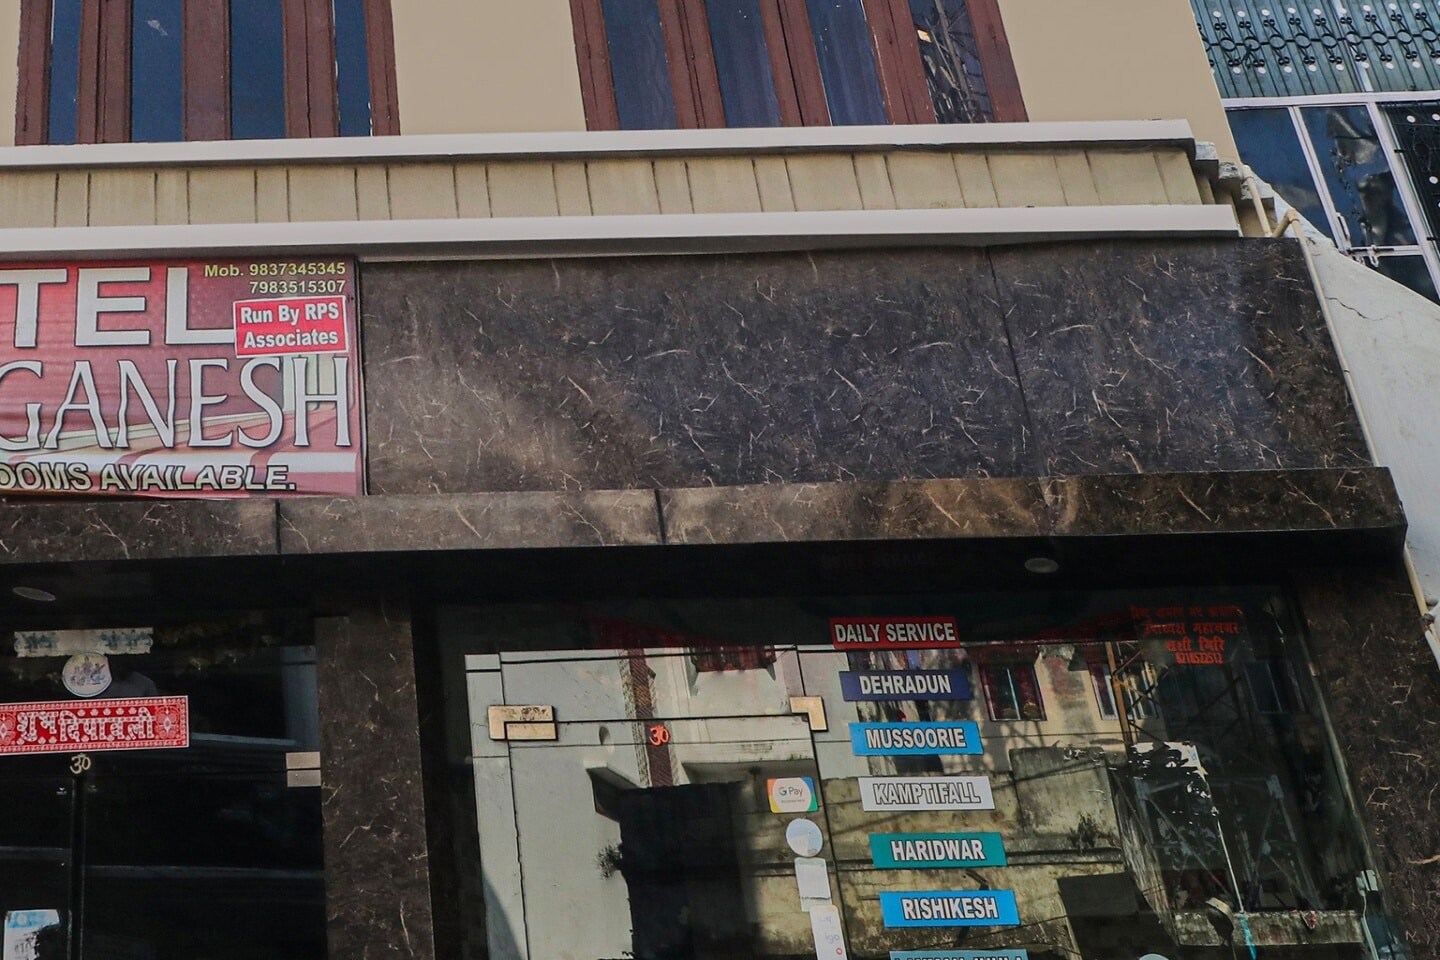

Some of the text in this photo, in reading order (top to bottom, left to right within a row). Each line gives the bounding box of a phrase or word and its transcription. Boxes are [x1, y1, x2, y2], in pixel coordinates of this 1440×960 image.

[204, 262, 346, 277] Mob. 9837345345
[249, 280, 346, 293] 7983515307
[240, 302, 340, 326] Run By RPS
[243, 328, 339, 349] Associates
[100, 464, 298, 491] AVAILABLE.
[834, 622, 957, 644] DAILY SERVICE
[860, 673, 952, 696] DEHRADUN
[16, 711, 58, 742] शुभ
[865, 727, 966, 750] MUSSOORIE
[788, 787, 804, 797] Pay
[873, 782, 982, 806] KAMPTIFALL
[890, 838, 986, 863] HARIDWAR
[902, 895, 1000, 921] RISHIKESH
